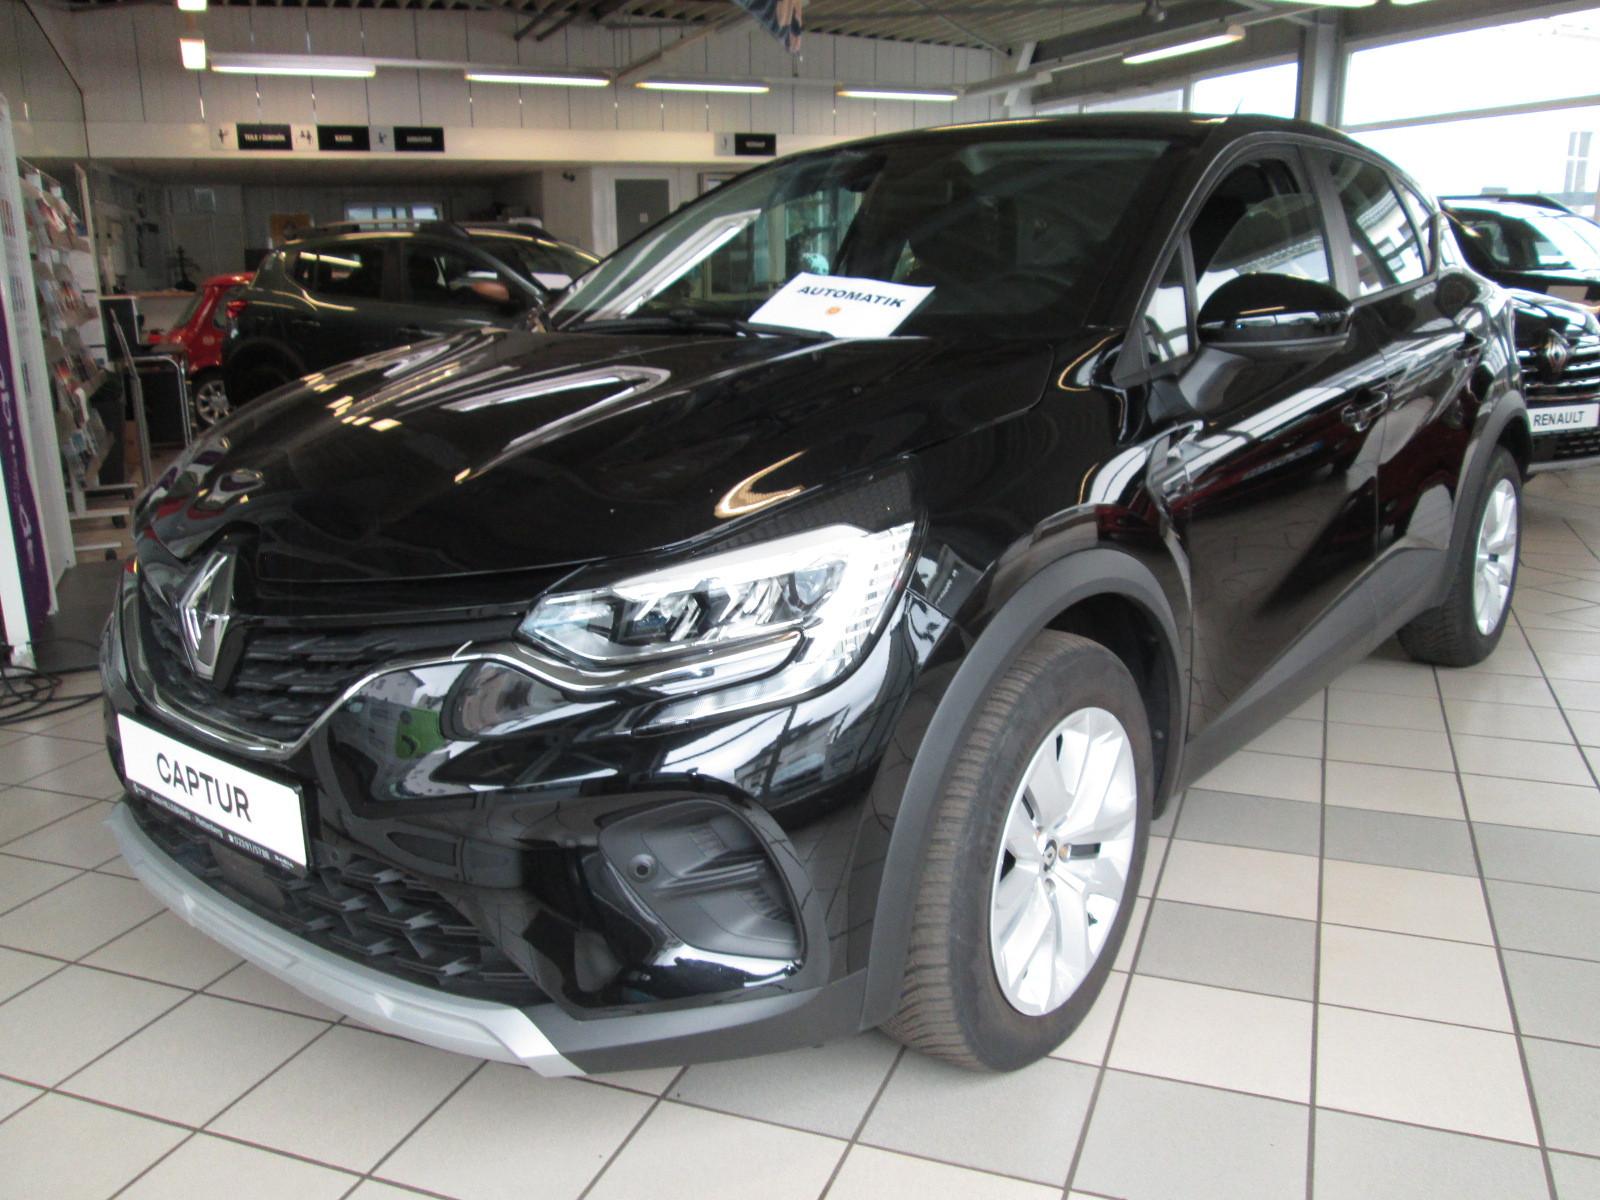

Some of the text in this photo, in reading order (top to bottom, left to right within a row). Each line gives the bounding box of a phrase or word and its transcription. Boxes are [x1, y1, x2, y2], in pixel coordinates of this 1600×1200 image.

[798, 286, 905, 308] AUTOMATIK
[1533, 410, 1585, 427] RENAULT
[156, 752, 252, 823] CAPTUR
